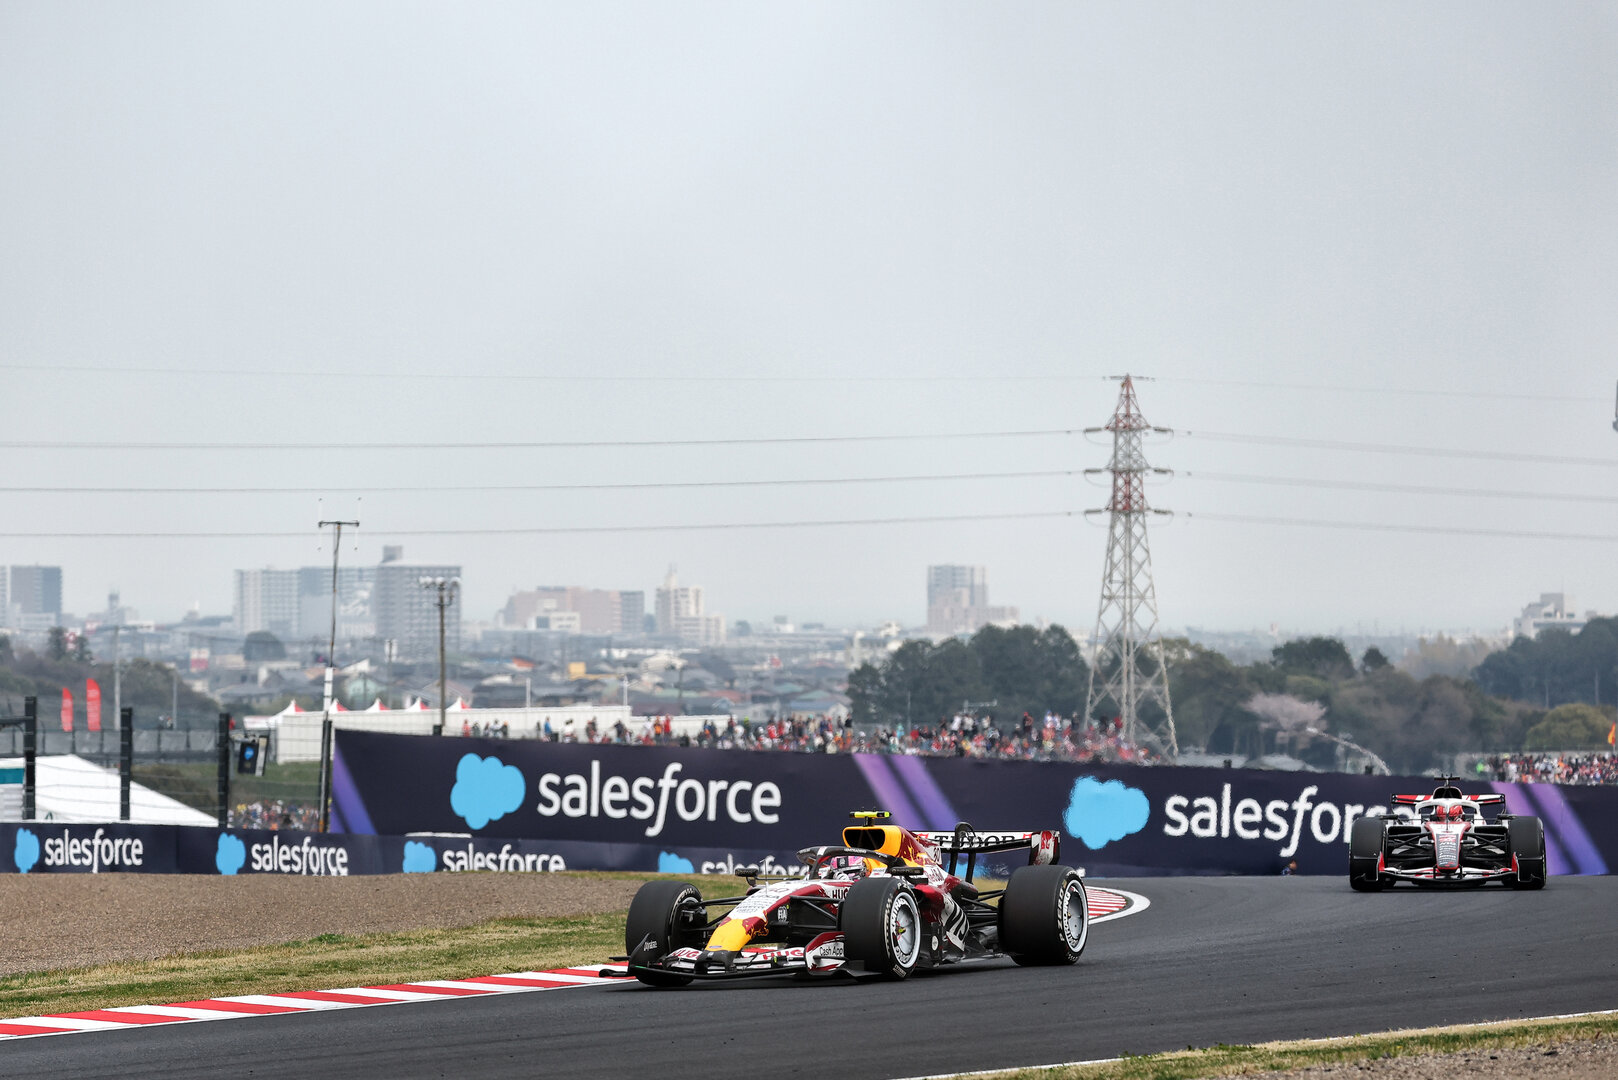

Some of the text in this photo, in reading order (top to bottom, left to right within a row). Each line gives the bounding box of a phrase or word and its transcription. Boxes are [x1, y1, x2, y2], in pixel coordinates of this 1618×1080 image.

[537, 760, 782, 837] salesforce
[44, 828, 144, 873] salesforce
[251, 836, 349, 876] salesforce
[819, 945, 844, 956] Cash App
